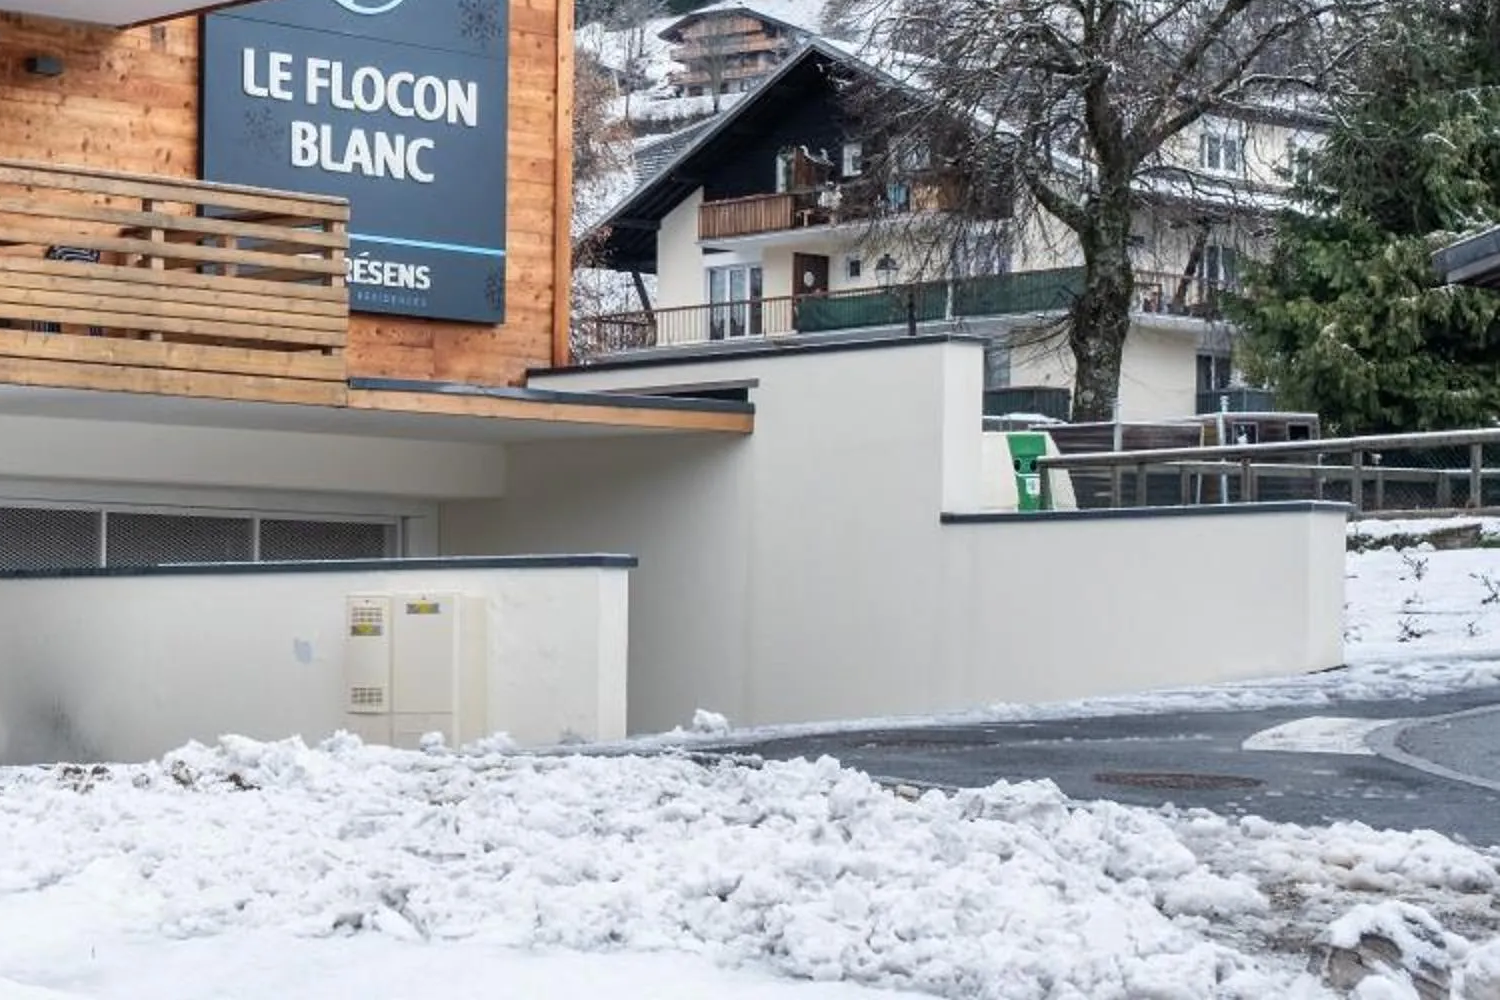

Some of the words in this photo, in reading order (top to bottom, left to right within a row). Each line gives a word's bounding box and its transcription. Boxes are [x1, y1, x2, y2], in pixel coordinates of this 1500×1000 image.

[242, 47, 293, 101] LE
[306, 57, 478, 127] FLOCON
[290, 120, 436, 183] BLANC
